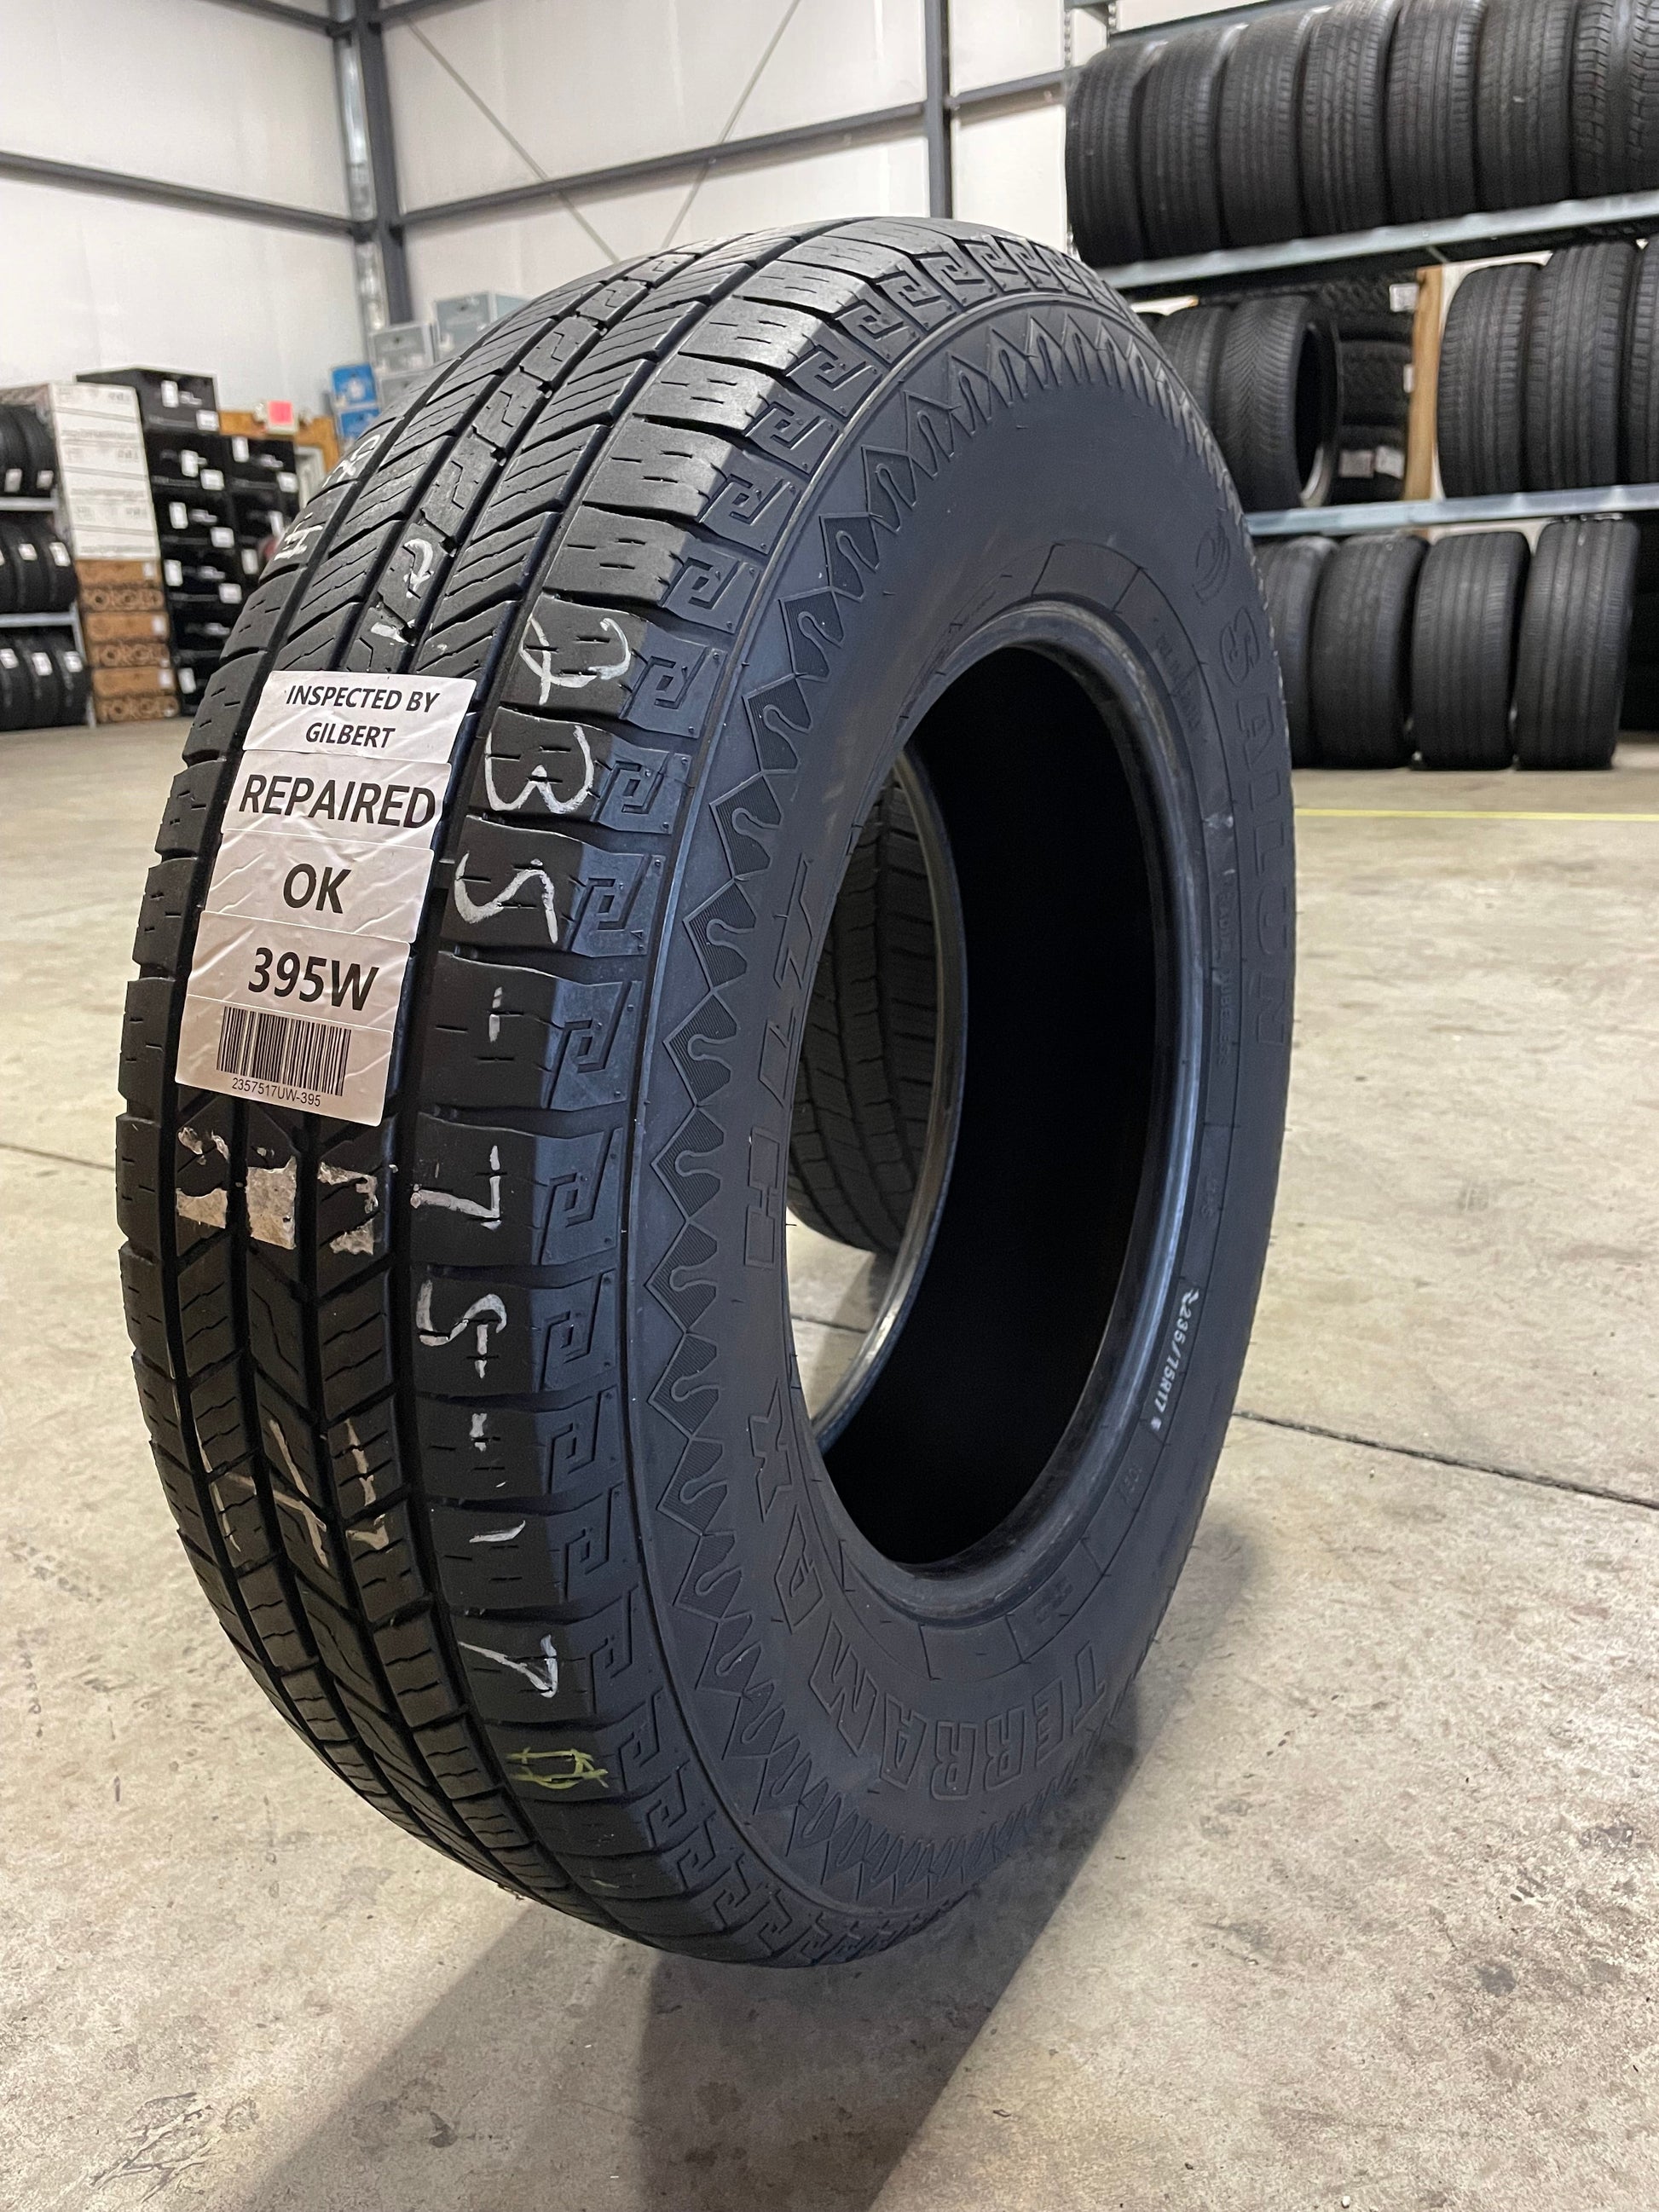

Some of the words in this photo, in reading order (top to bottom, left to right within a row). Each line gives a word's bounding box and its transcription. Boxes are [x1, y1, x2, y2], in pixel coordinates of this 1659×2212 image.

[286, 684, 402, 710] INSPECTED
[406, 691, 440, 713] BY
[305, 722, 396, 748] GILBERT
[239, 773, 436, 829] REPAIRED
[282, 863, 350, 915] OK
[247, 946, 380, 1011] 395W
[232, 1077, 321, 1107] 2357517UW-395
[1153, 1306, 1191, 1413] 235/75R17
